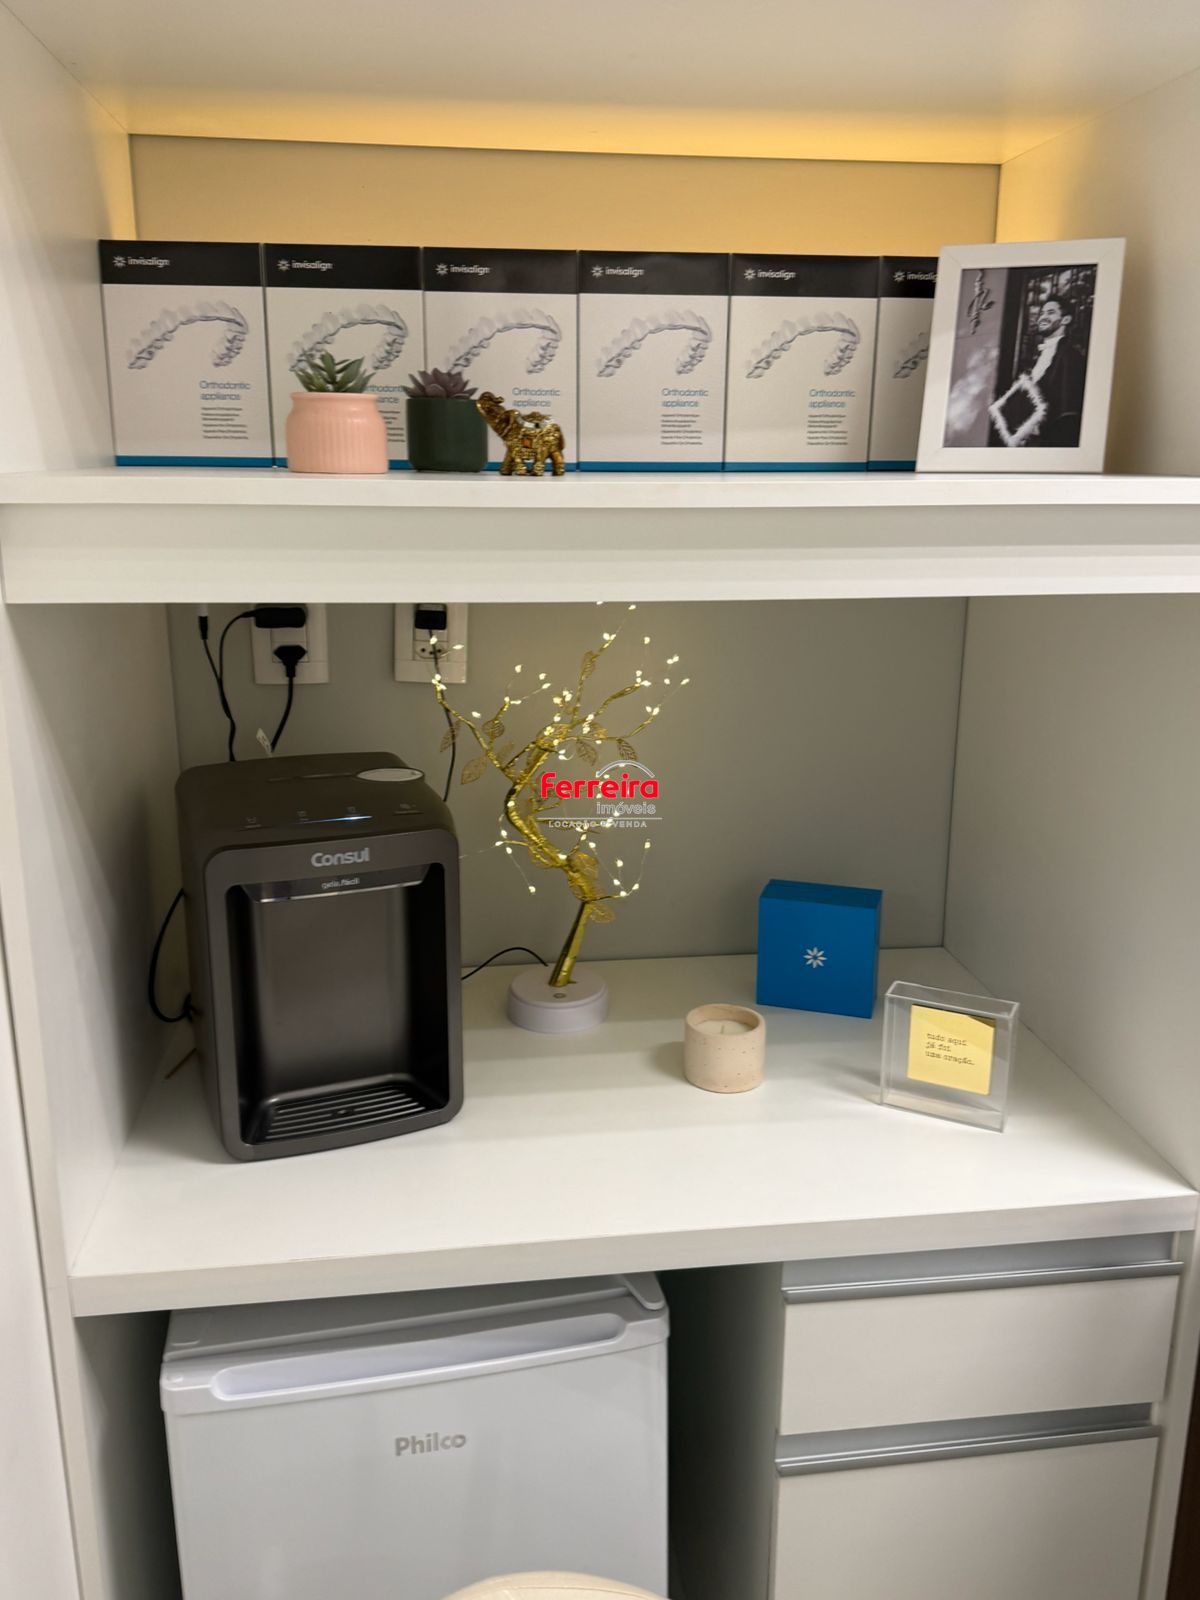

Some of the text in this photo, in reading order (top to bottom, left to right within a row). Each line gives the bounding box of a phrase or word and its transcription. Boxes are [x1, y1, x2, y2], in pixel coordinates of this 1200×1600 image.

[127, 256, 170, 268] invisalign
[291, 259, 333, 271] invisalign
[449, 264, 490, 275] invisalign
[605, 266, 644, 278] invisalign
[757, 269, 796, 280] invisalign
[199, 380, 251, 390] Orthodontic
[511, 387, 561, 397] Orthodontic
[661, 387, 709, 397] Orthodontic
[809, 388, 856, 398] Orthodontic
[311, 847, 370, 867] Consul
[395, 1431, 467, 1457] Philco
